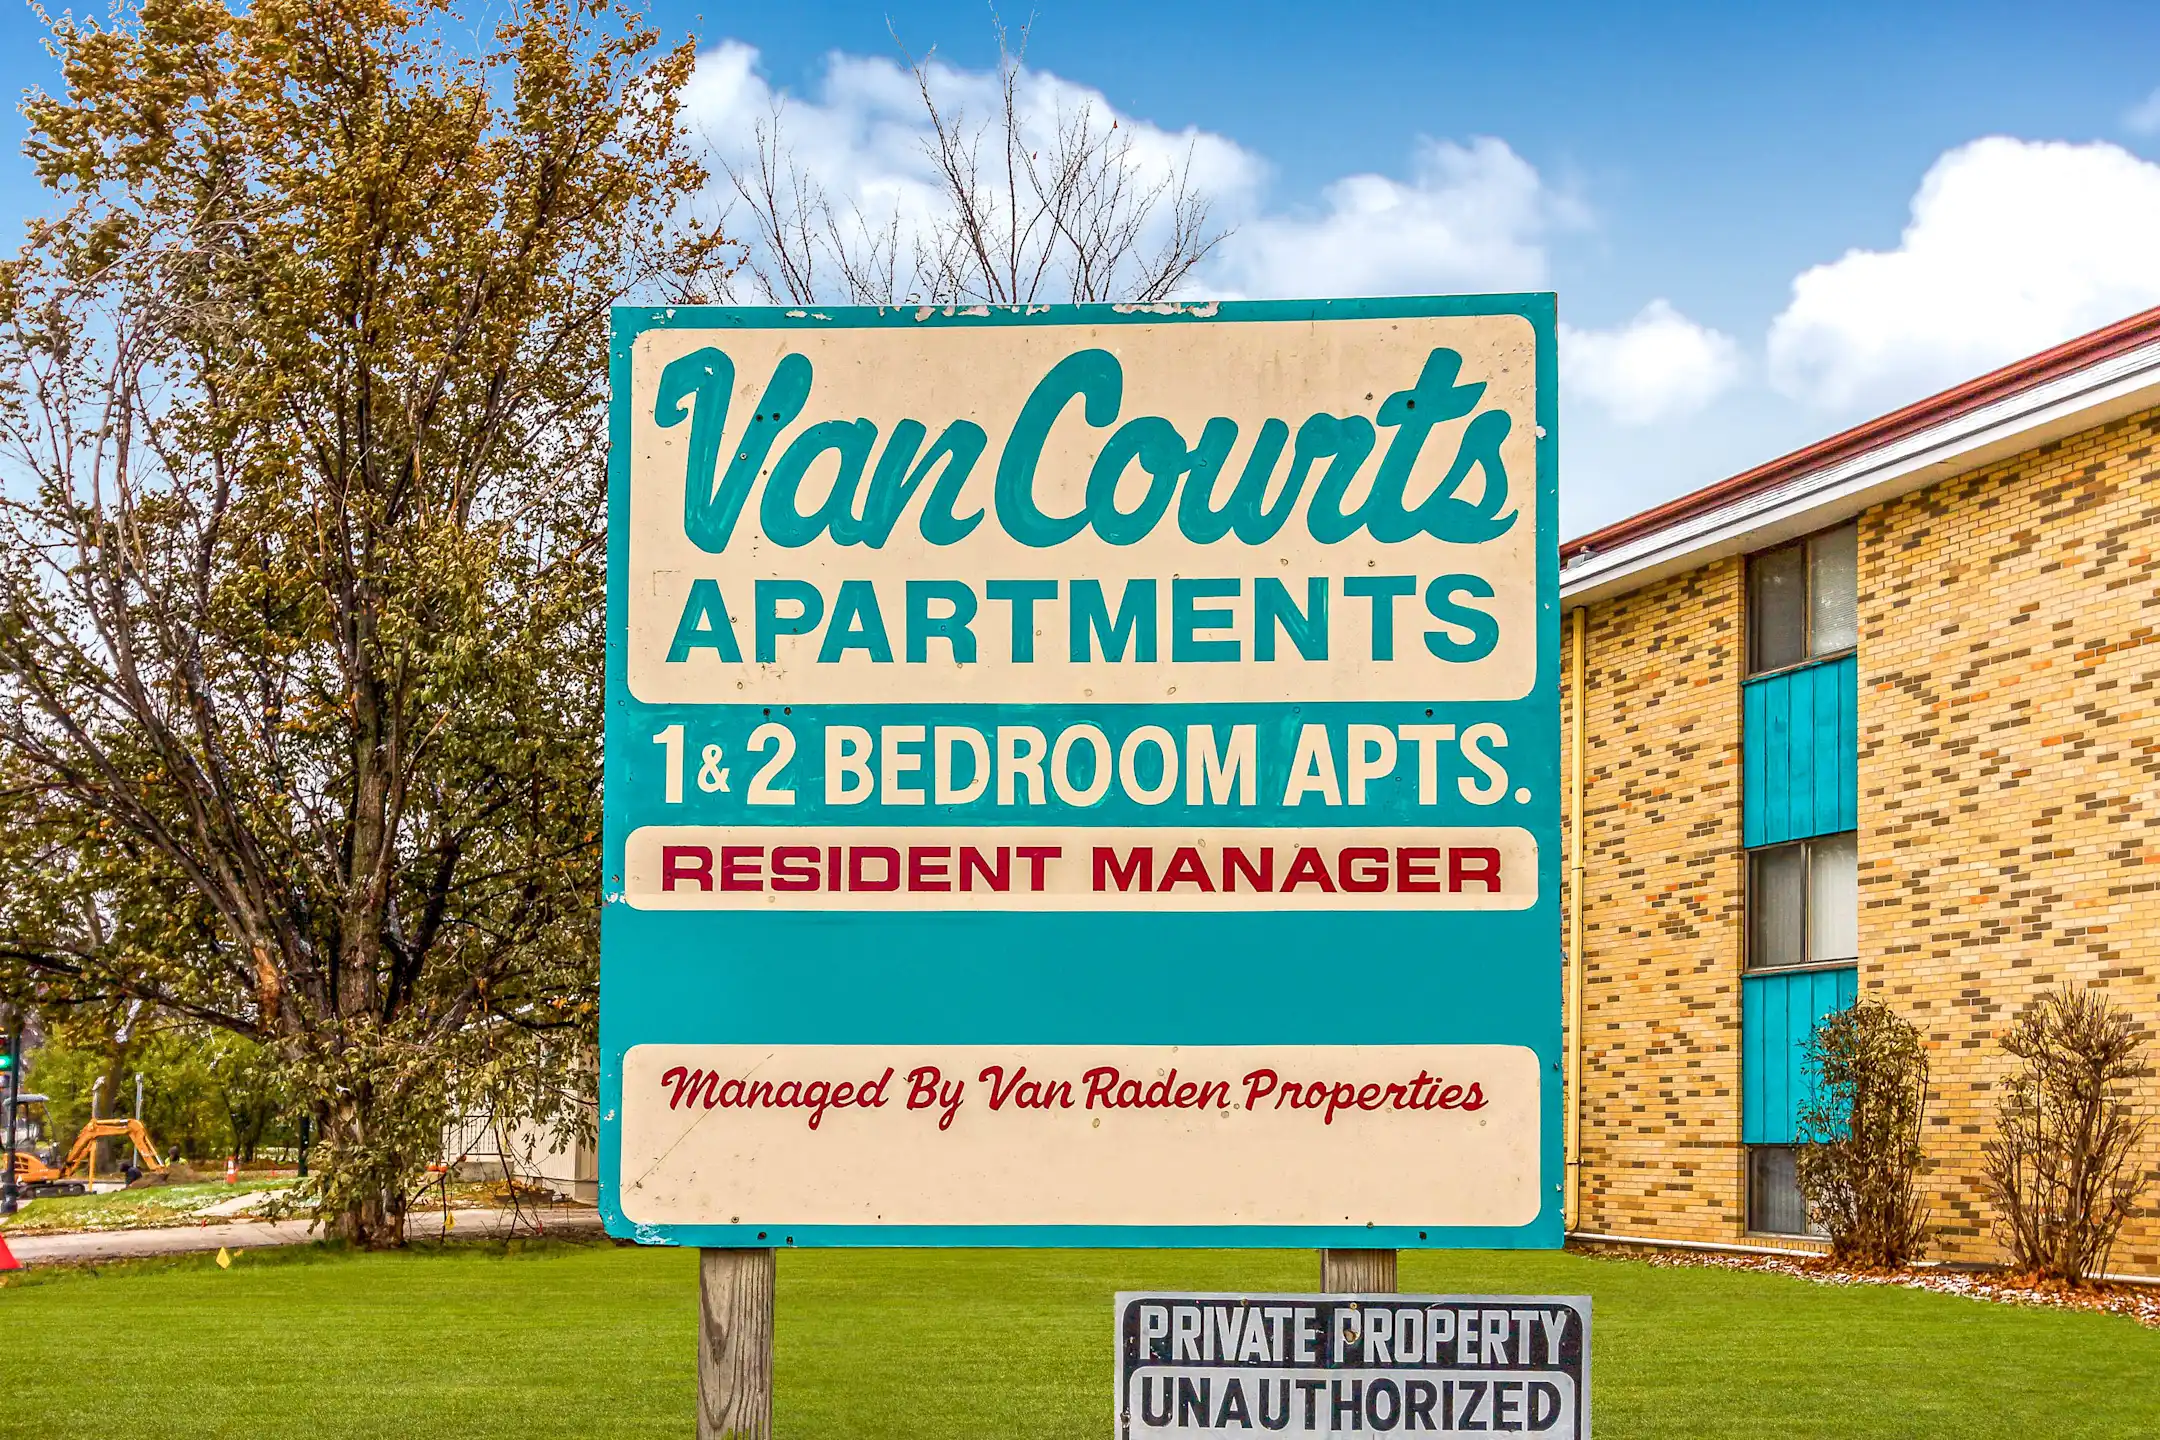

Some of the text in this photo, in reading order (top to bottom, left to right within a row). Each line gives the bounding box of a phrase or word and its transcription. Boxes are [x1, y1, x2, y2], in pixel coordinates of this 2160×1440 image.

[665, 573, 1500, 664] APARTMENTS
[825, 724, 1257, 806] BEDROOM
[1282, 722, 1532, 806] APTS.
[662, 845, 1501, 893] RESIDENT MANAGER
[661, 1065, 1489, 1131] Managed By Van Raden Properties
[1139, 1304, 1568, 1365] PRIVATE PROPERTY
[1141, 1376, 1562, 1432] UNAUTHORIZED
